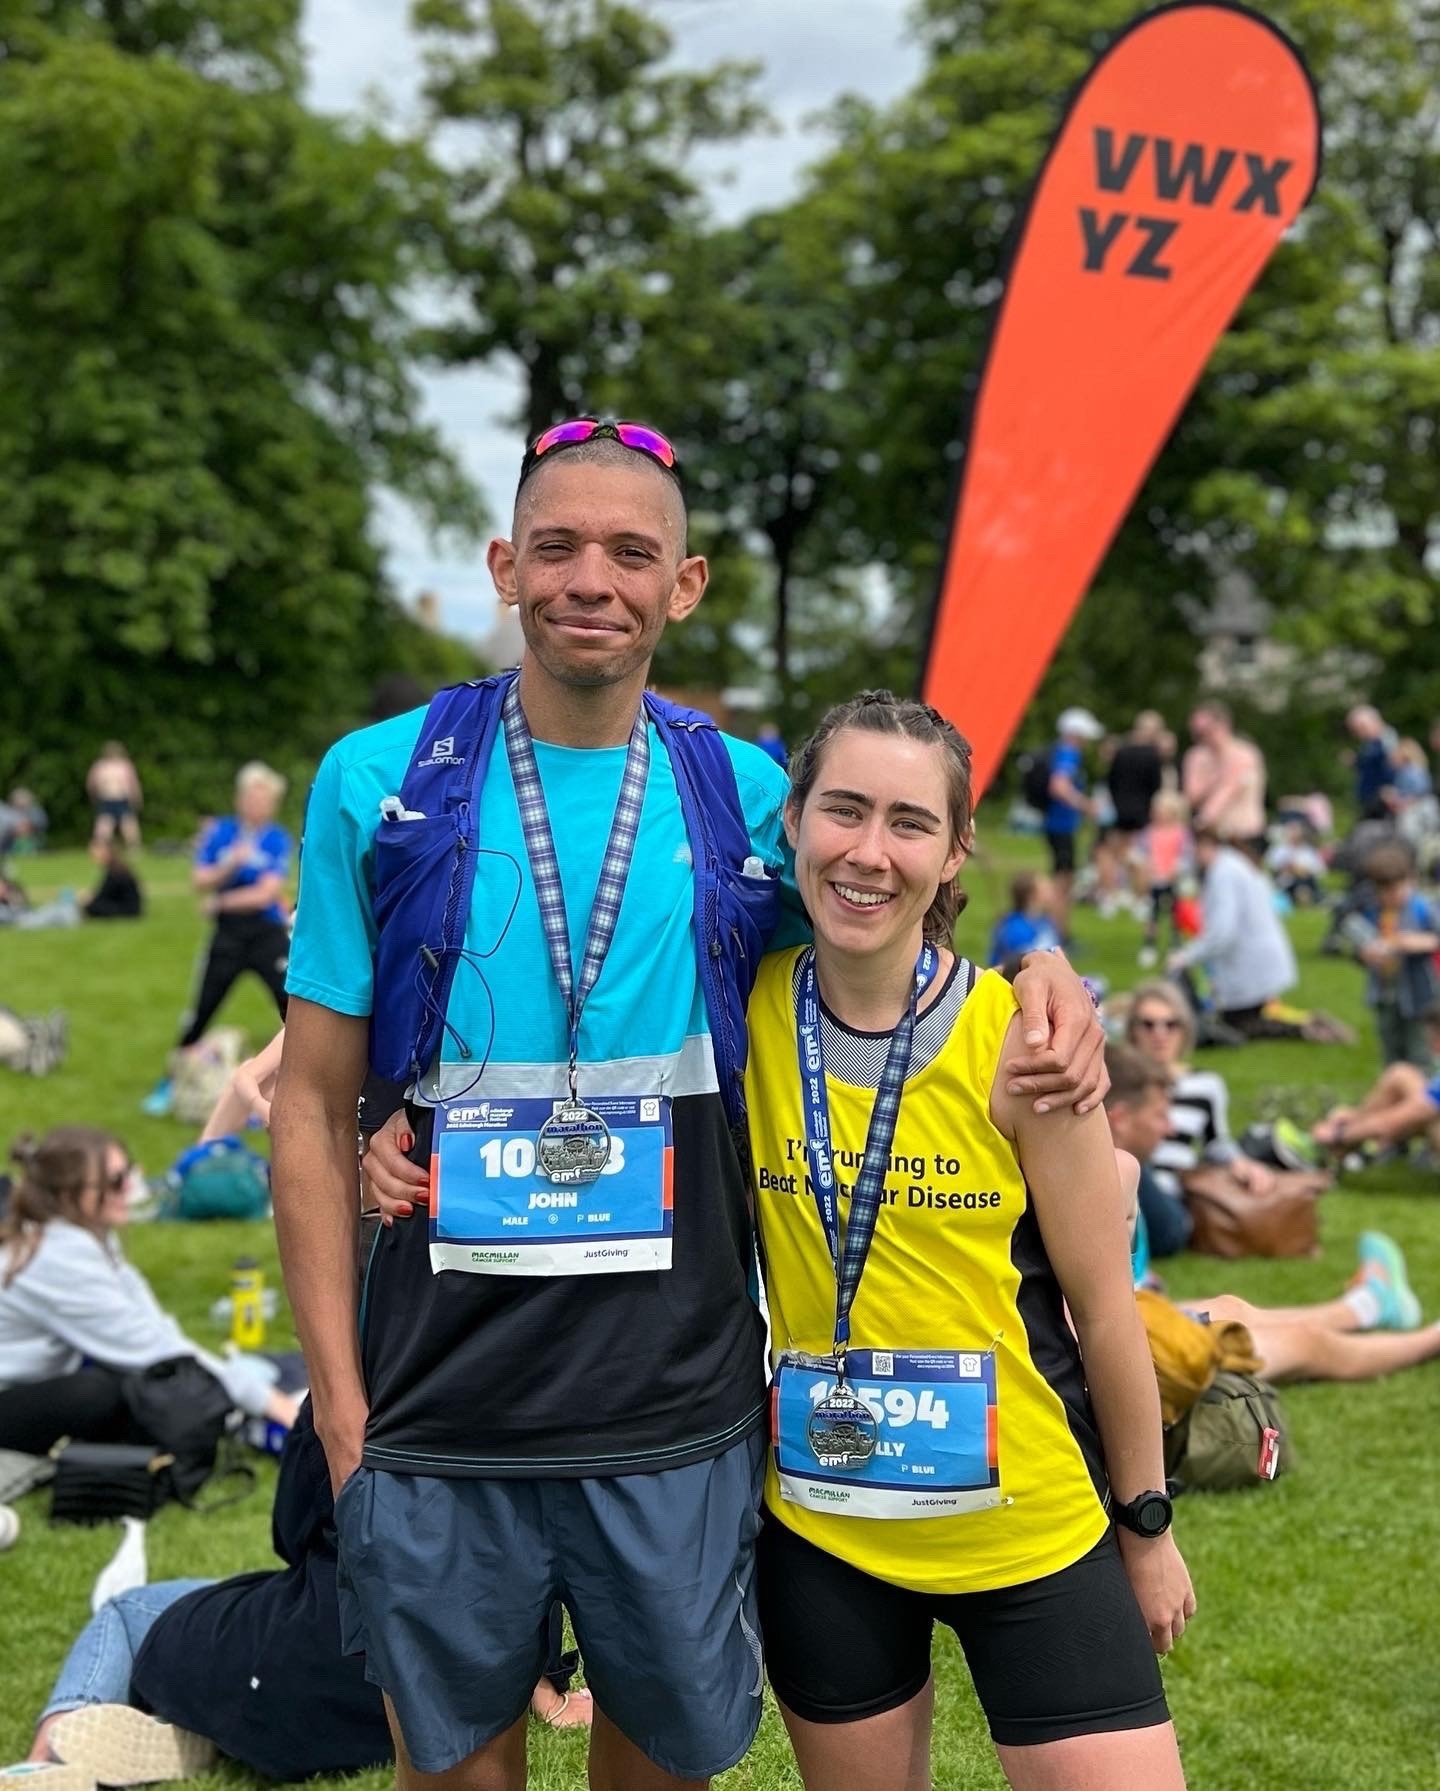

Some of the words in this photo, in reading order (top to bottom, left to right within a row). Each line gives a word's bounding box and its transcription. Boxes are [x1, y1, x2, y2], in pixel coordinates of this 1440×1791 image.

[1093, 126, 1293, 217] VWX
[1078, 207, 1180, 280] YZ
[800, 1025, 821, 1072] emf
[809, 1077, 820, 1104] 2022
[446, 1103, 490, 1123] emf
[562, 1111, 588, 1121] 2022
[546, 1122, 603, 1133] marathon
[809, 1138, 834, 1189] emf
[934, 1153, 960, 1175] to
[551, 1168, 581, 1184] emf
[759, 1167, 798, 1195] Beat
[908, 1185, 1001, 1209] Disease
[528, 1192, 578, 1210] JOHN
[824, 1194, 835, 1223] 2022
[502, 1216, 529, 1226] MALE
[587, 1213, 611, 1223] BLUE
[584, 1249, 629, 1258] JustGiving
[810, 1381, 950, 1429] 1594
[829, 1399, 855, 1409] 2022
[819, 1453, 849, 1467] emf
[911, 1465, 936, 1475] BLUE
[808, 1487, 851, 1499] MACMILLAN
